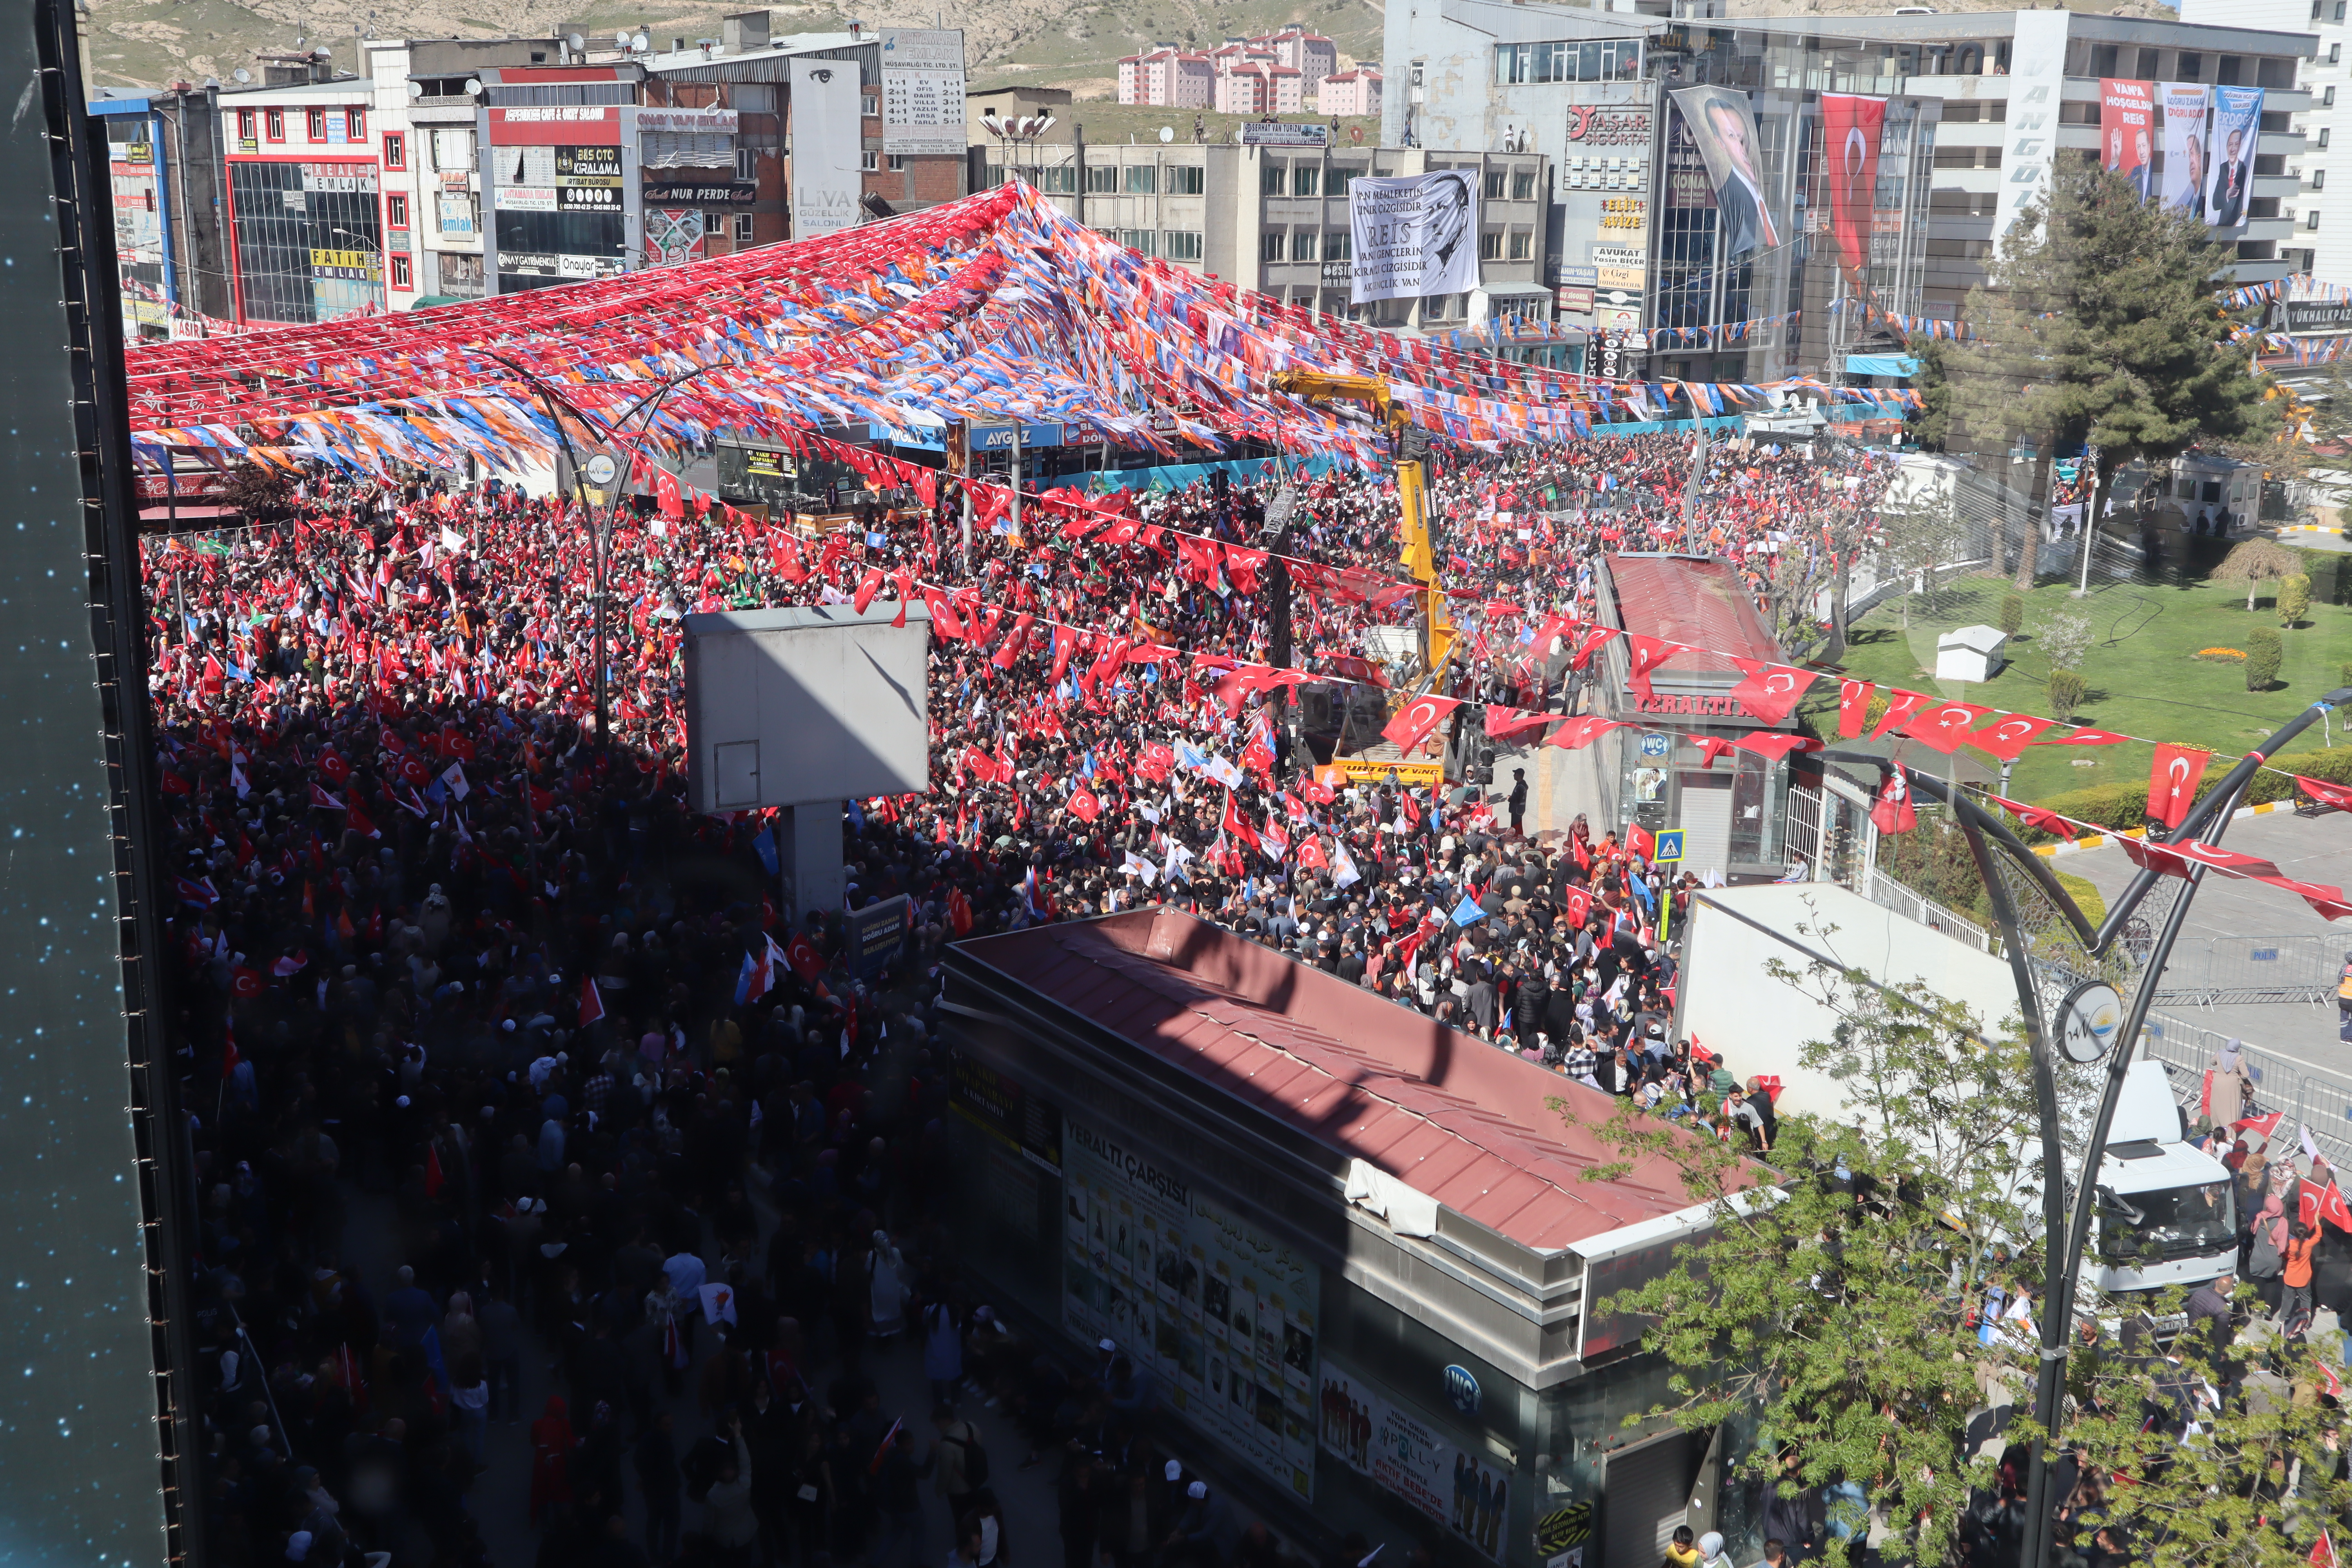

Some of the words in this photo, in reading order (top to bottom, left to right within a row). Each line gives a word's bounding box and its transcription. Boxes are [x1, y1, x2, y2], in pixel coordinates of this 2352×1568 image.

[899, 32, 960, 45] AHTAMARA
[906, 47, 955, 60] EMLAK
[638, 113, 667, 125] ONAY
[671, 114, 695, 125] YAPI
[698, 115, 737, 126] EMLAK
[1585, 114, 1647, 133] YAŞAR
[2123, 112, 2145, 125] REİS
[1252, 124, 1271, 132] SERHAT
[1585, 132, 1646, 145] SİGORTA
[596, 149, 614, 160] OTO
[1668, 153, 1679, 165] VAN
[314, 163, 353, 176] REAL
[573, 163, 620, 174] KİRALAMA
[318, 178, 367, 190] EMLAK
[588, 177, 610, 185] BÜROSU
[504, 189, 534, 199] AHTAMARA
[535, 190, 554, 199] EMLAK
[671, 189, 692, 200] NUR
[697, 189, 730, 200] PERDE
[799, 187, 852, 207] LİVA
[1356, 191, 1370, 200] VAN
[1373, 186, 1423, 200] MEMLEKETİN
[1379, 200, 1422, 215] ÇİZGİSİDİR
[1608, 196, 1637, 211] ELİT
[800, 208, 849, 217] GÜZELLİK
[442, 216, 472, 231] emlak
[1603, 213, 1640, 227] AVİZE
[1367, 218, 1411, 247] REİS
[312, 250, 365, 267] FATİH
[1377, 245, 1423, 259] GENÇLERİN
[1599, 248, 1640, 257] AVUKAT
[519, 255, 555, 267] GAYRİMENKUL
[563, 258, 594, 274] Onaylar
[1381, 260, 1427, 275] ÇİZGİSİDİR
[1620, 257, 1644, 266] BİÇER
[314, 266, 365, 279] EMLAK
[1611, 269, 1629, 279] Çizgi
[1322, 277, 1332, 287] cafe
[1401, 278, 1420, 286] VAN
[460, 286, 470, 294] OKEY
[1568, 291, 1588, 300] SİGORTA
[1155, 419, 1175, 430] ÖMER
[1633, 693, 1733, 716] YERALTI
[1647, 738, 1662, 749] WC
[862, 922, 880, 934] DOĞRU
[881, 915, 899, 927] ZAMAN
[863, 929, 882, 942] DOĞRU
[884, 922, 900, 934] ADAM
[863, 935, 900, 956] BULUŞUYOR
[2254, 950, 2276, 960] POLİS
[970, 1059, 997, 1086] VAKIF
[956, 1066, 980, 1090] KİTAP
[982, 1083, 1013, 1112] SARAYI
[970, 1089, 1005, 1119] KIRTASİYE
[1066, 1116, 1122, 1169] YERALTI
[1125, 1155, 1188, 1207] ÇARŞISI
[1451, 1370, 1473, 1402] WC
[1391, 1410, 1406, 1425] TÜM
[1409, 1420, 1429, 1439] OKUL
[1387, 1416, 1433, 1450] KIYAFETLERİ
[1391, 1433, 1440, 1474] POLL-Y
[1376, 1458, 1401, 1481] AKTİF
[1403, 1476, 1443, 1509] BEBE'DE
[1374, 1469, 1446, 1523] SATILMAKTADIR
[1540, 1526, 1552, 1536] OKUL
[1553, 1516, 1577, 1531] SEZONUNU
[1577, 1511, 1590, 1521] AÇTIK
[1551, 1530, 1564, 1541] AKTİF
[1566, 1525, 1578, 1534] BEBE
